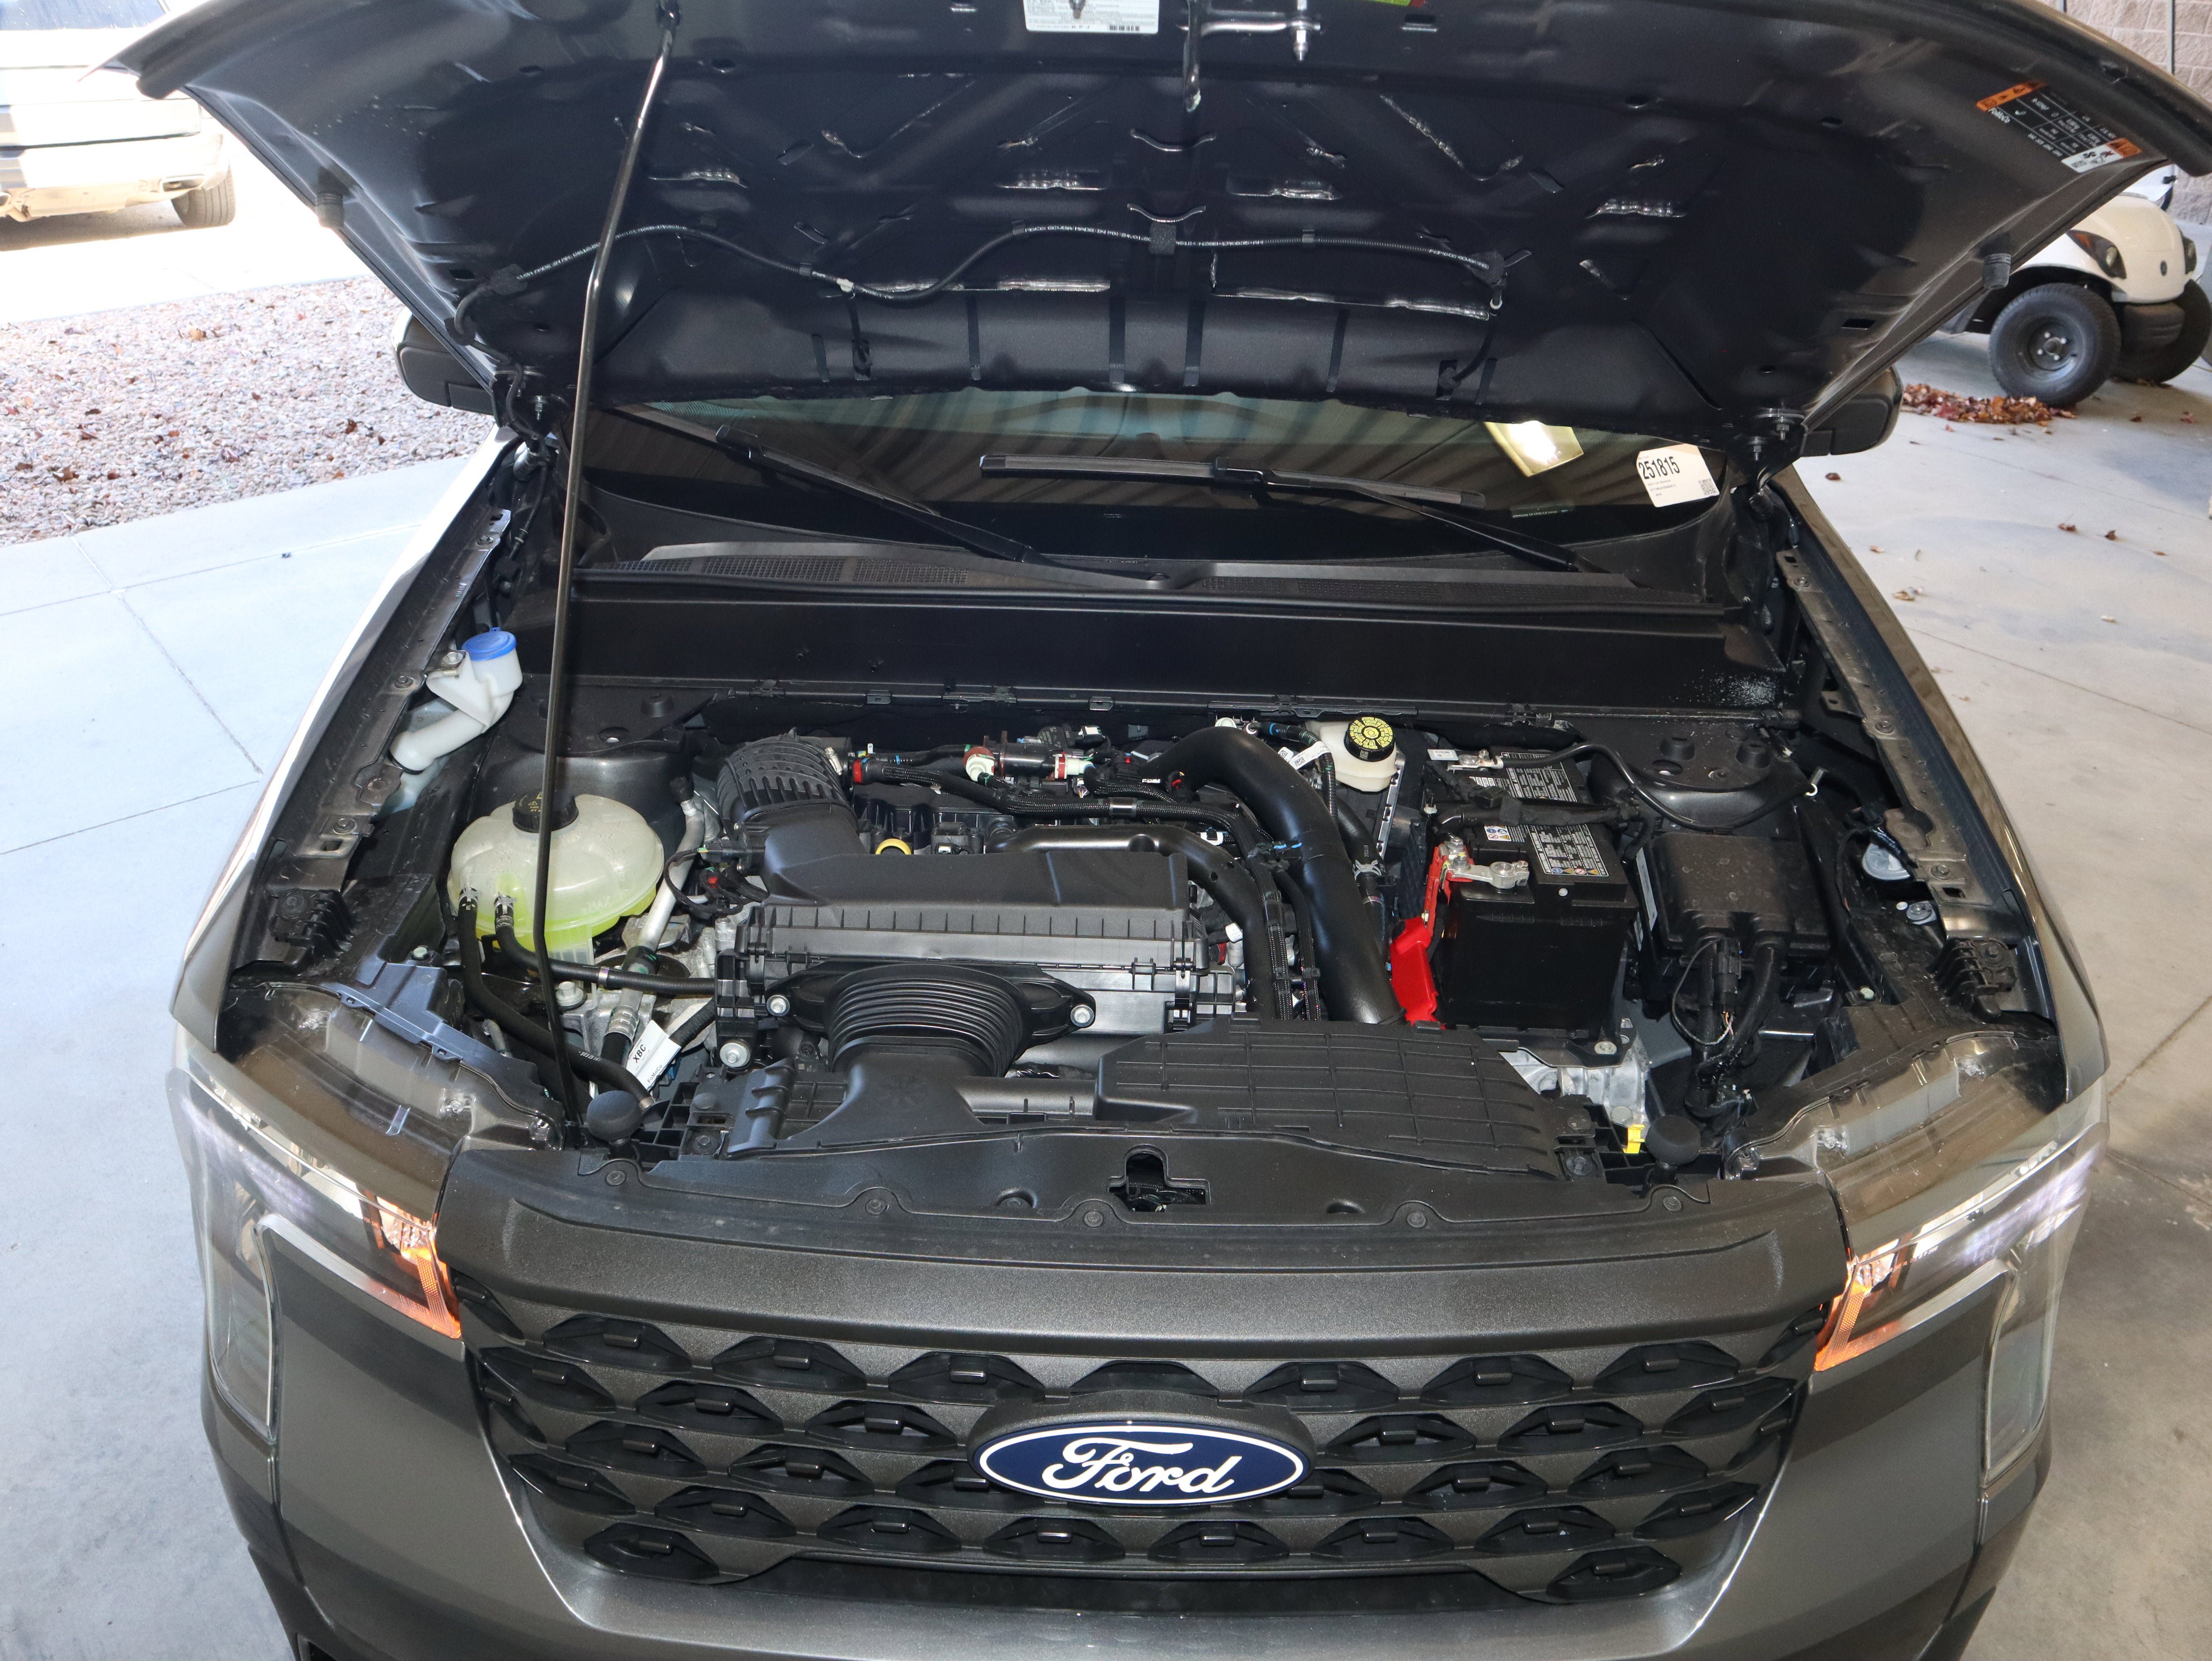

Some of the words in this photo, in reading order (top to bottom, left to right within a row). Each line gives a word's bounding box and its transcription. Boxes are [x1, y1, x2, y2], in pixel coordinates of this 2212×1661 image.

[1988, 107, 2011, 123] FoMoCo
[1638, 456, 1680, 480] 251815
[633, 1044, 646, 1063] XBC
[647, 1064, 663, 1083] FoMoCo
[1042, 1437, 1242, 1493] Ford
